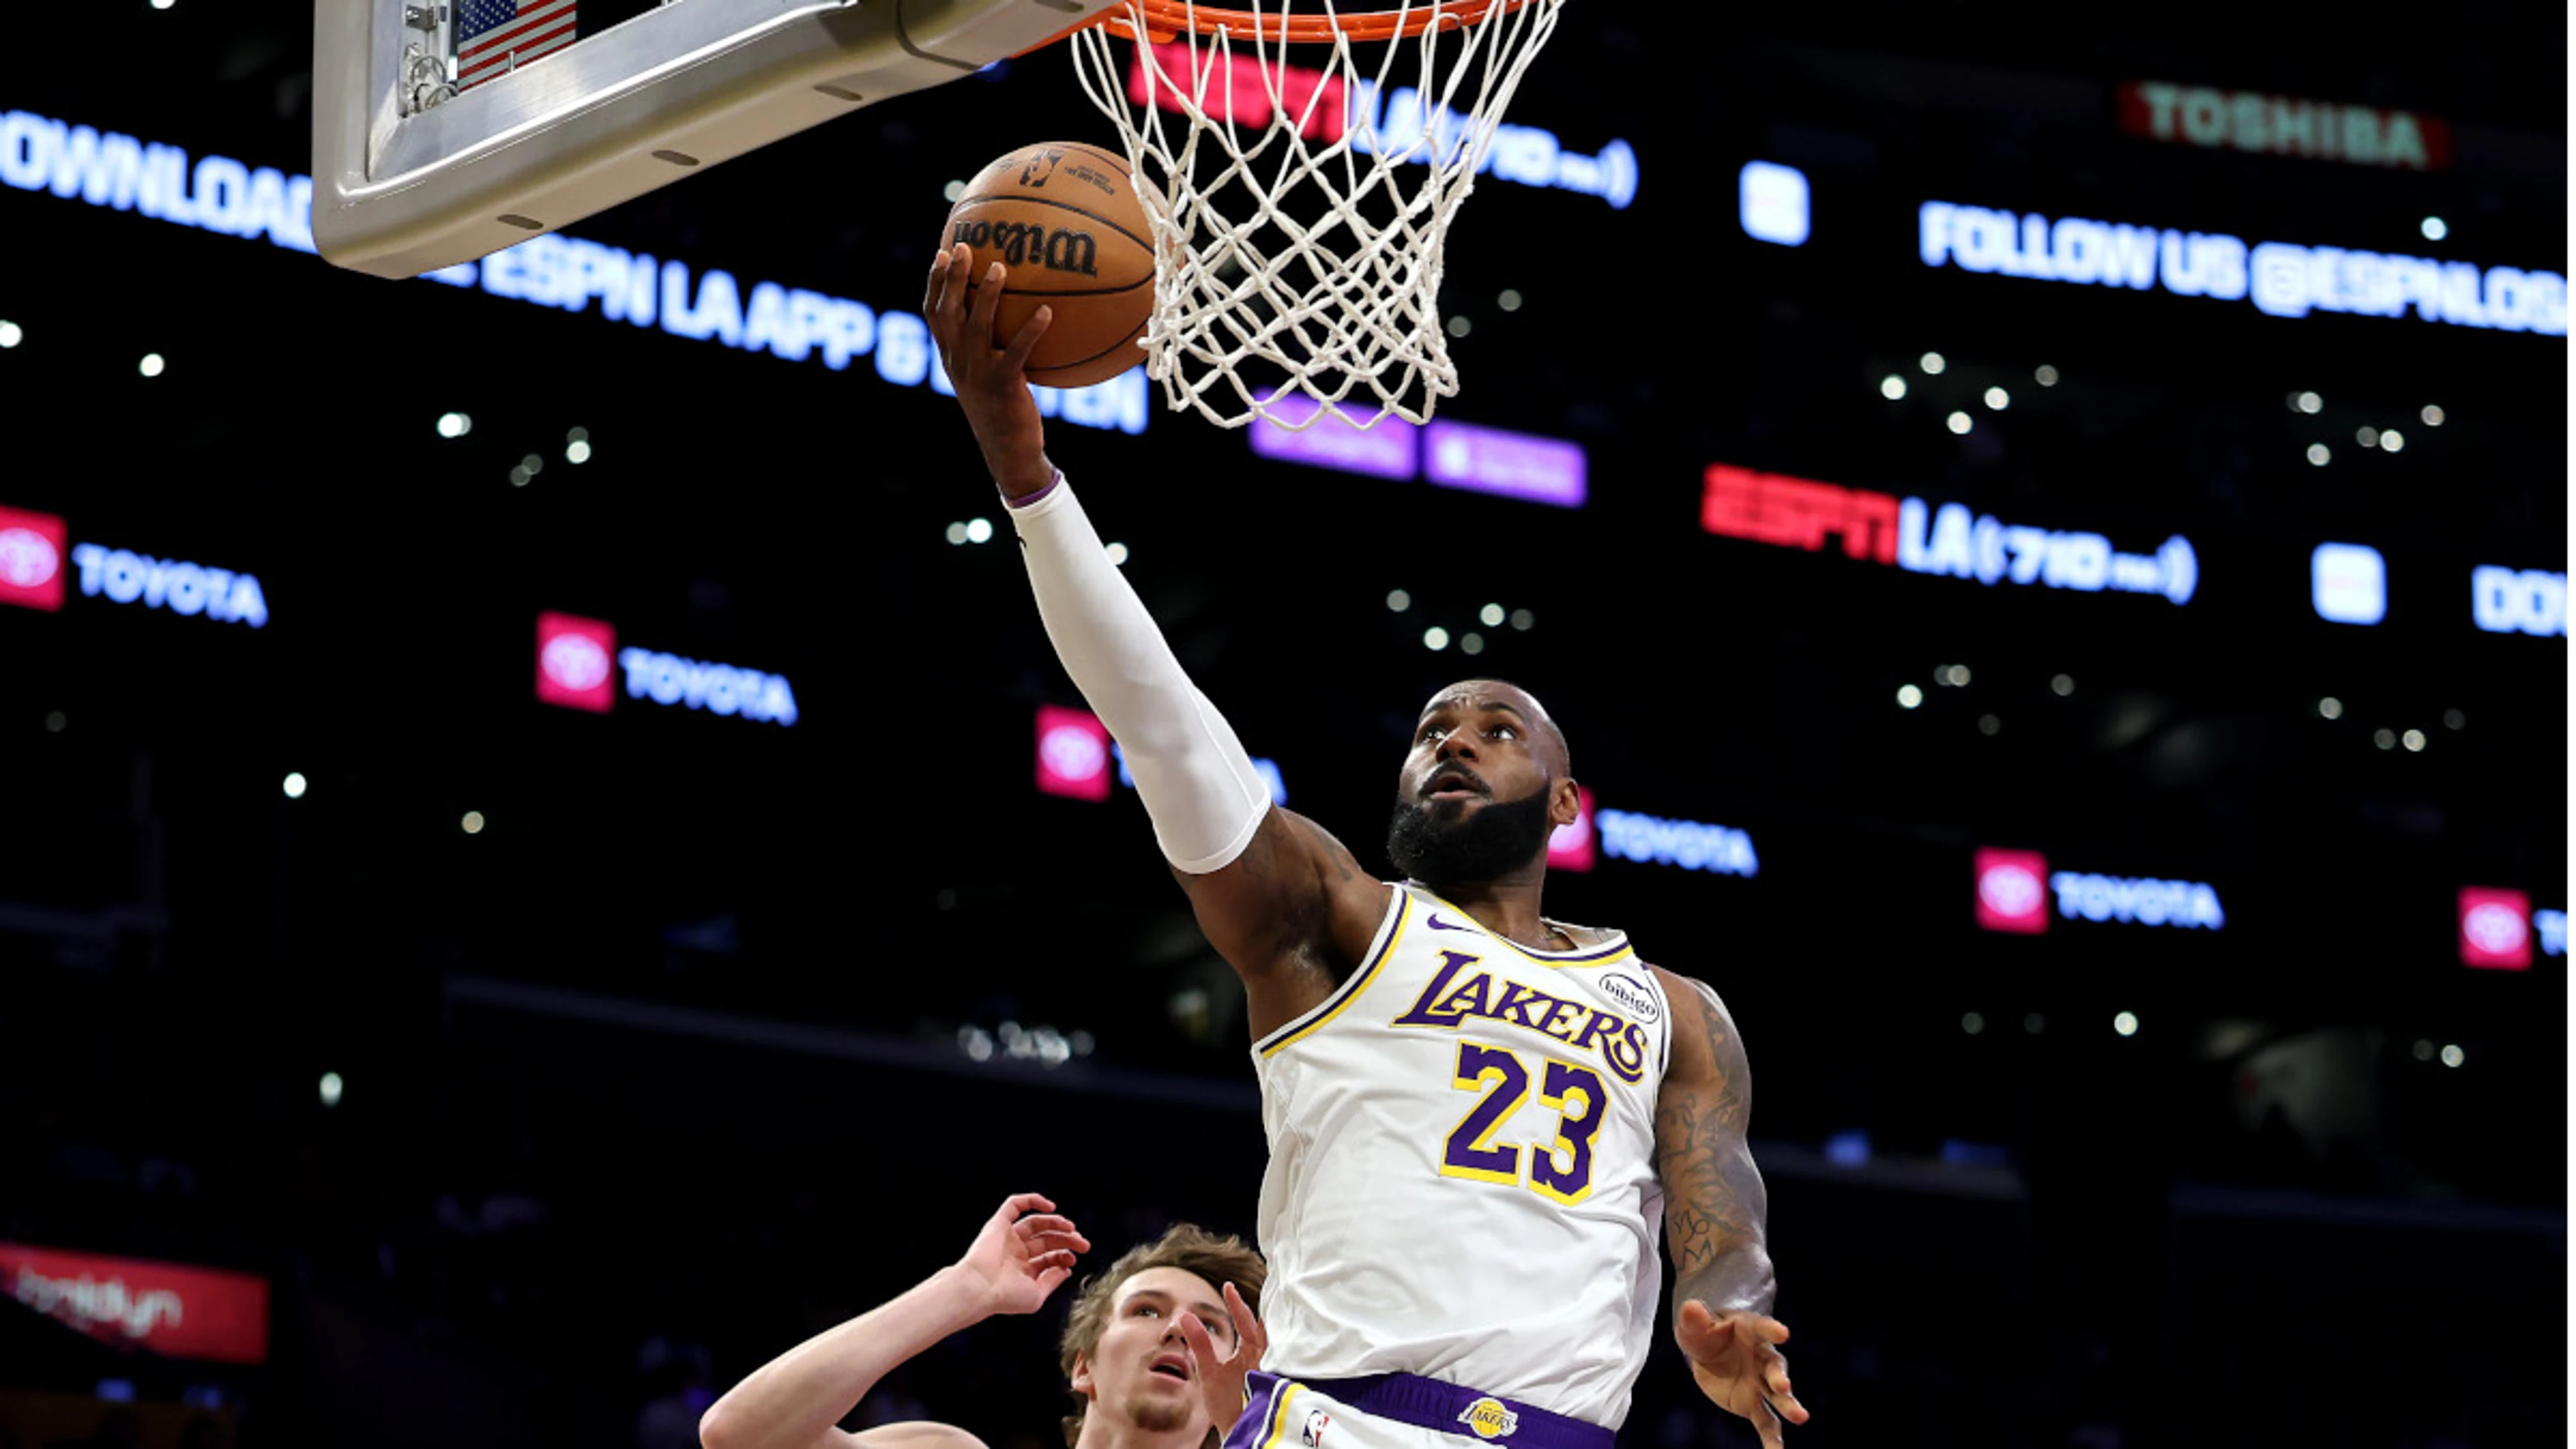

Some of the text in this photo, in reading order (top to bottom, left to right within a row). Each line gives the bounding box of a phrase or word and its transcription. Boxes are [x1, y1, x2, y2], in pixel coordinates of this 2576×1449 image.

[2136, 80, 2428, 169] TOSHIBA
[953, 219, 1097, 278] Wilson
[1919, 199, 2157, 290] FOLLOW
[2159, 229, 2249, 300] US
[660, 260, 741, 347] LA
[743, 281, 876, 370] APP
[1701, 462, 1898, 566] ESPN
[71, 541, 270, 628] TOYOTA
[2471, 564, 2567, 637] DO
[617, 646, 798, 727] TOYOTA
[1595, 808, 1760, 878] TOYOTA
[2049, 869, 2226, 930] TOYOTA
[1390, 949, 1648, 1086] LAKERS
[1605, 979, 1656, 1016] bibigo
[1439, 1038, 1611, 1207] 23
